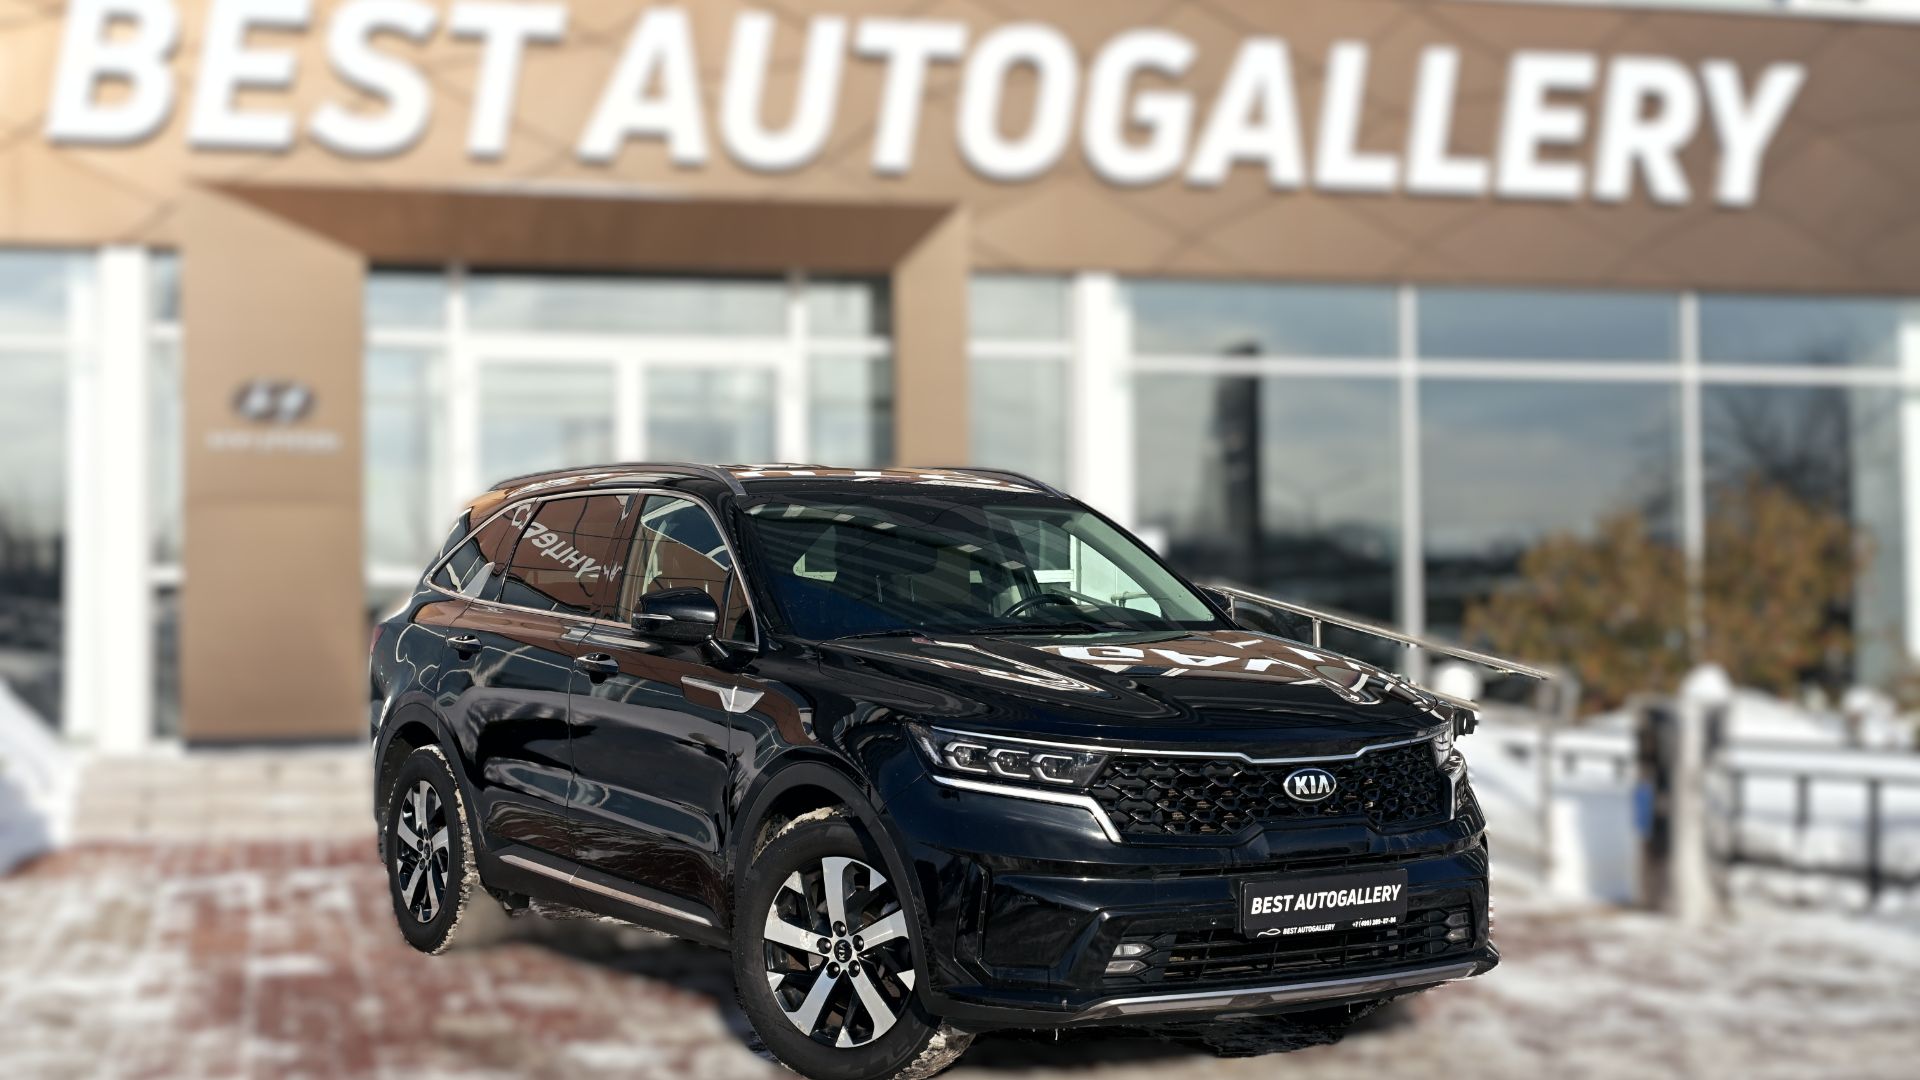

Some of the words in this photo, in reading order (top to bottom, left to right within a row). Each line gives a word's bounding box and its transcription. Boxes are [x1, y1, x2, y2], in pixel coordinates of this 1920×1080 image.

[46, 0, 568, 156] BEST
[579, 9, 1806, 204] AUTOGALLERY
[1293, 775, 1331, 795] KIA
[1251, 895, 1294, 914] BEST
[1294, 884, 1401, 911] AUTOGALLERY
[1282, 926, 1298, 935] BEST
[1298, 923, 1336, 934] AUTOGALLERY
